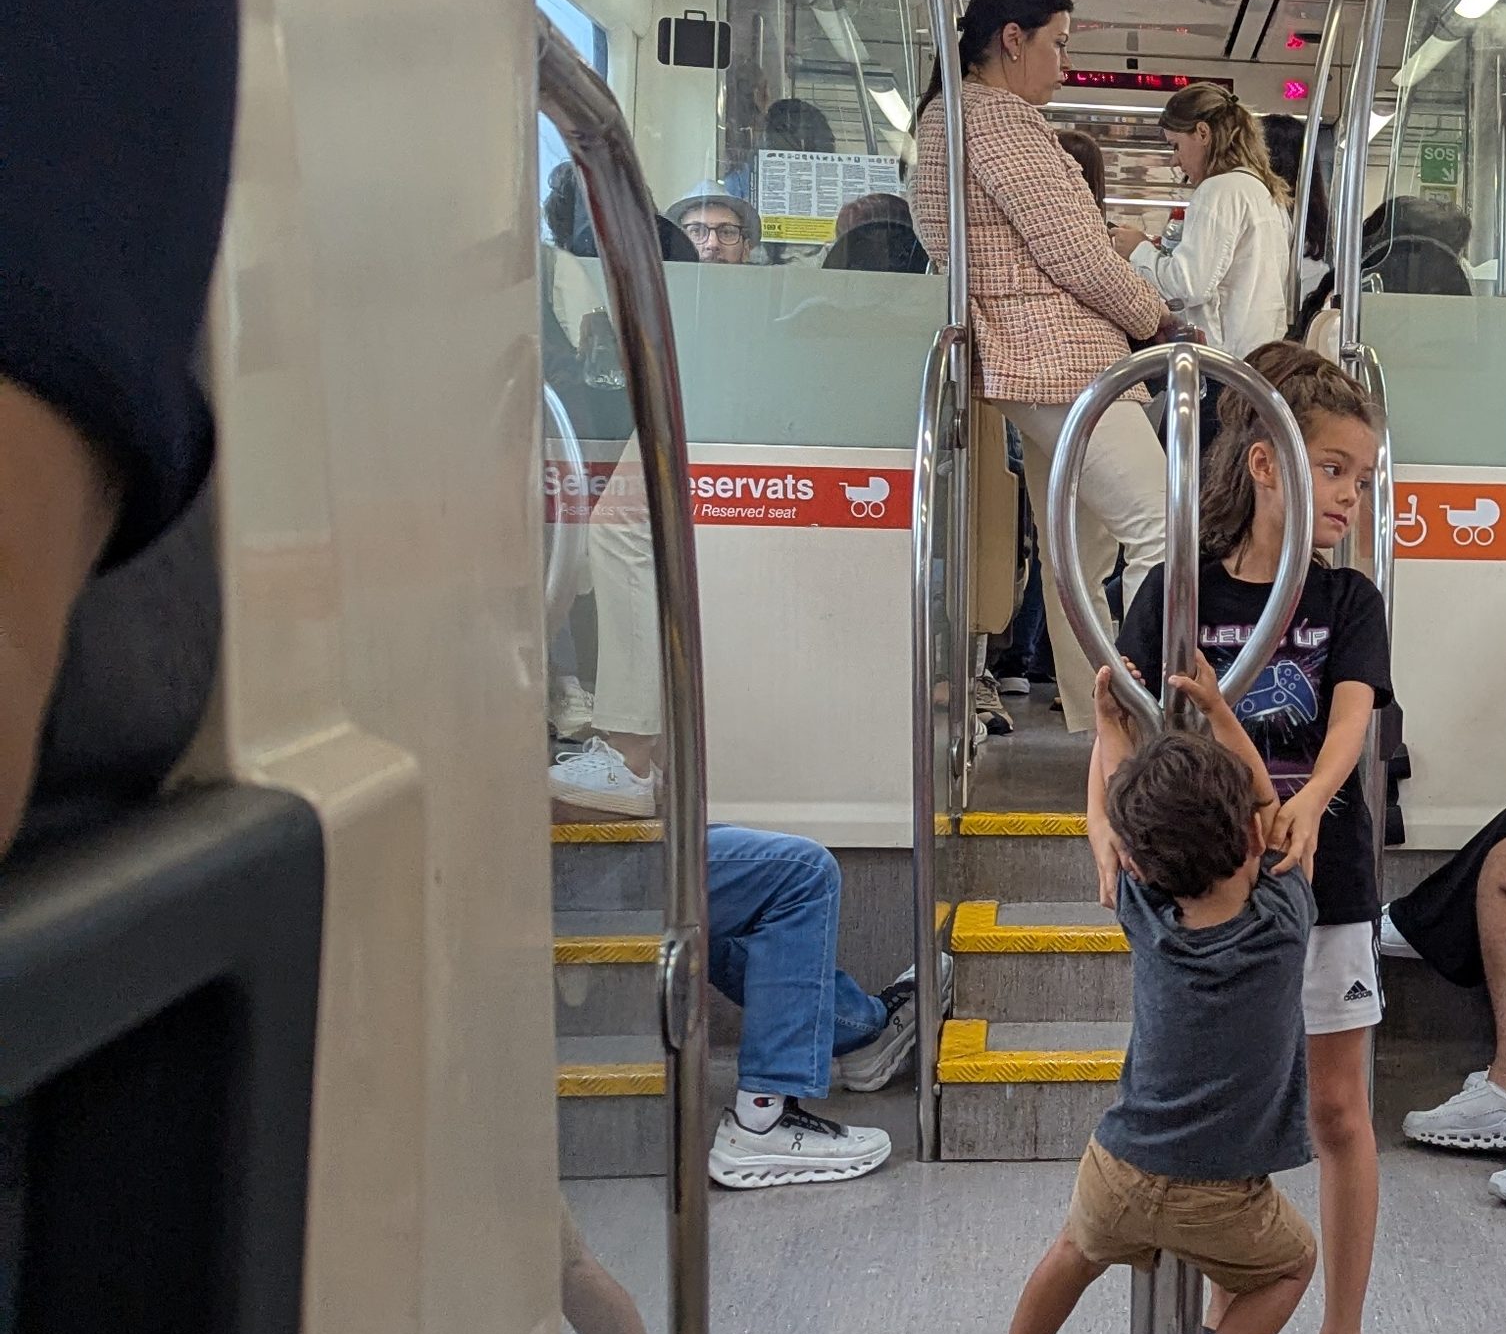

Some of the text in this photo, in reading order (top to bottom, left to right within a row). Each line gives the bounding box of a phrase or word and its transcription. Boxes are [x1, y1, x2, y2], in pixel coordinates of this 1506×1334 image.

[1424, 147, 1456, 161] SOS
[688, 474, 814, 500] servats
[701, 503, 766, 518] Reserved
[768, 506, 797, 519] seat
[1296, 629, 1328, 646] UP
[1343, 990, 1373, 1002] adidas
